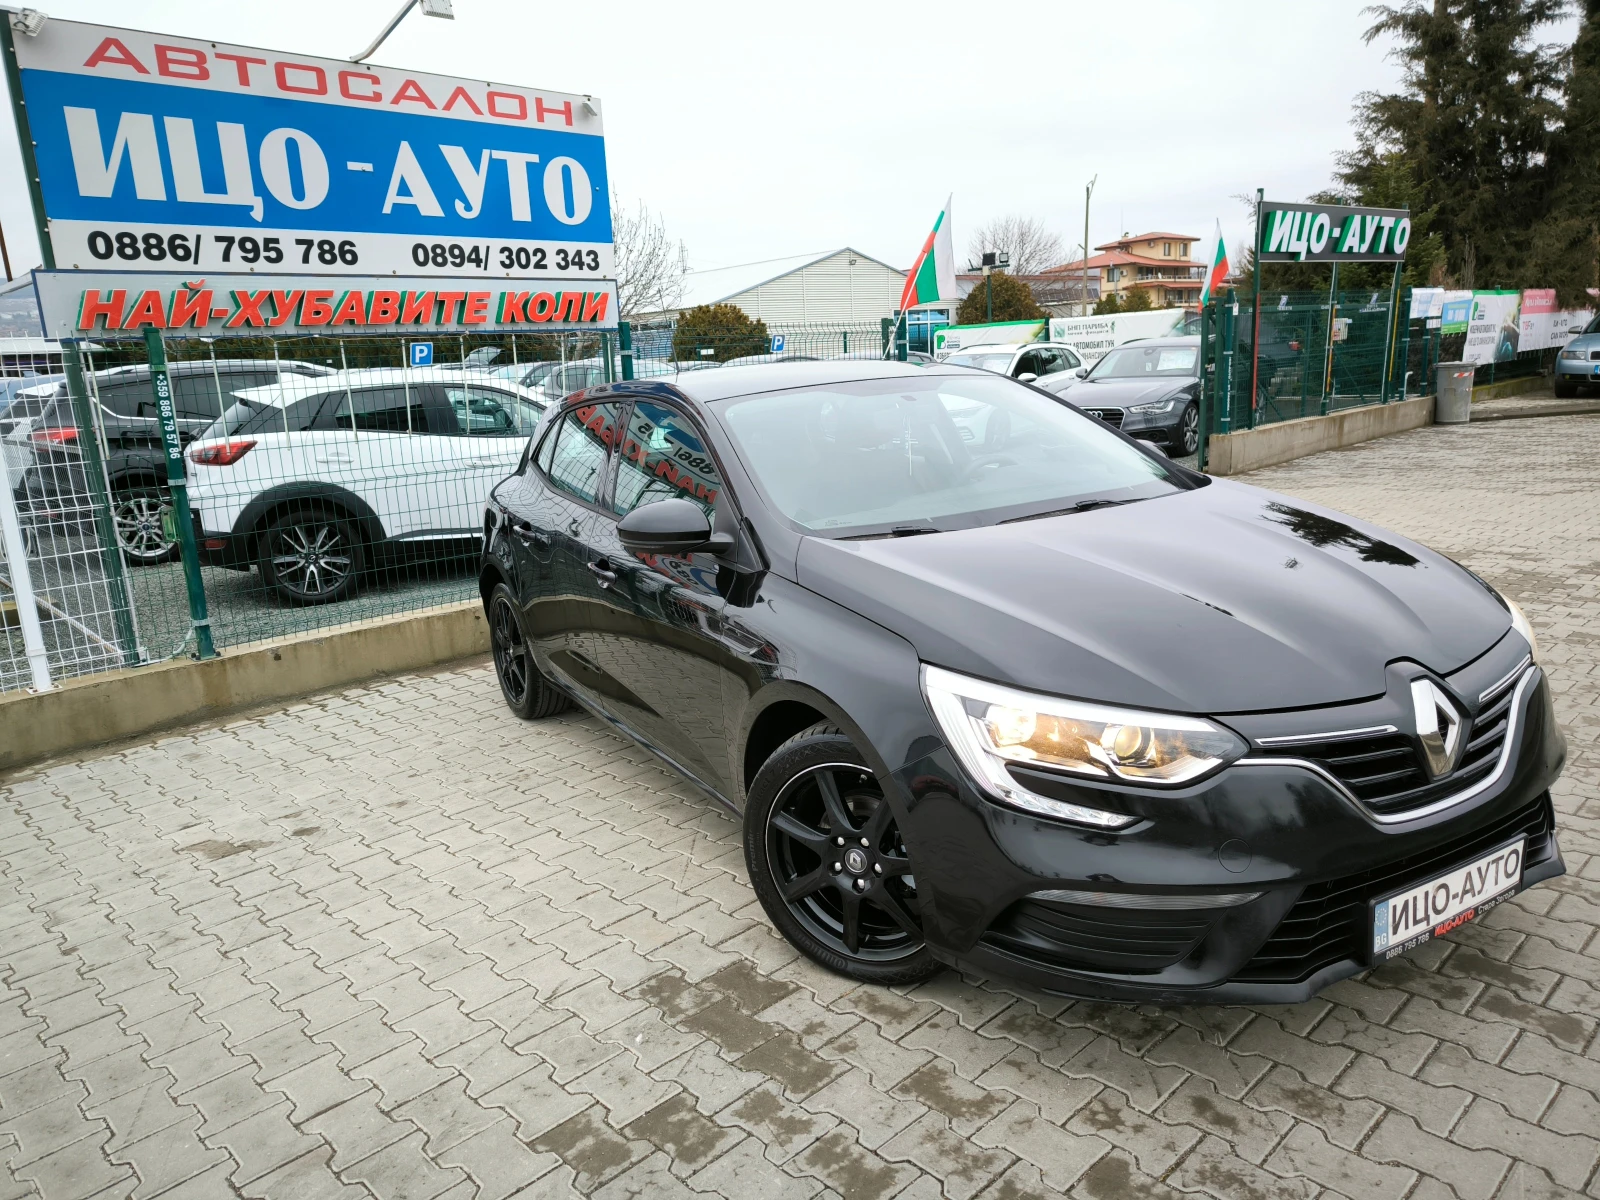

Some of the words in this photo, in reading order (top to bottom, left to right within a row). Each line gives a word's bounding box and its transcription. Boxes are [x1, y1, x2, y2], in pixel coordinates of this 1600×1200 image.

[83, 37, 574, 126] АВТОСАЛОН
[1266, 210, 1411, 261] ИЦО-АУТО
[87, 230, 201, 265] 0886/
[214, 235, 284, 264] 795
[295, 238, 359, 266] 786
[411, 242, 490, 271] 0894/
[499, 247, 548, 271] 302
[555, 249, 600, 271] 343
[77, 279, 490, 331] НАЙ-ХУБАВИТЕ
[498, 289, 609, 326] КОЛИ
[414, 346, 429, 364] P
[157, 374, 169, 397] +359
[160, 400, 172, 417] 886
[163, 420, 175, 431] 79
[166, 434, 178, 445] 57
[168, 447, 180, 459] 86
[1391, 848, 1520, 936] ИЦО-АУТО
[1375, 932, 1388, 947] BG
